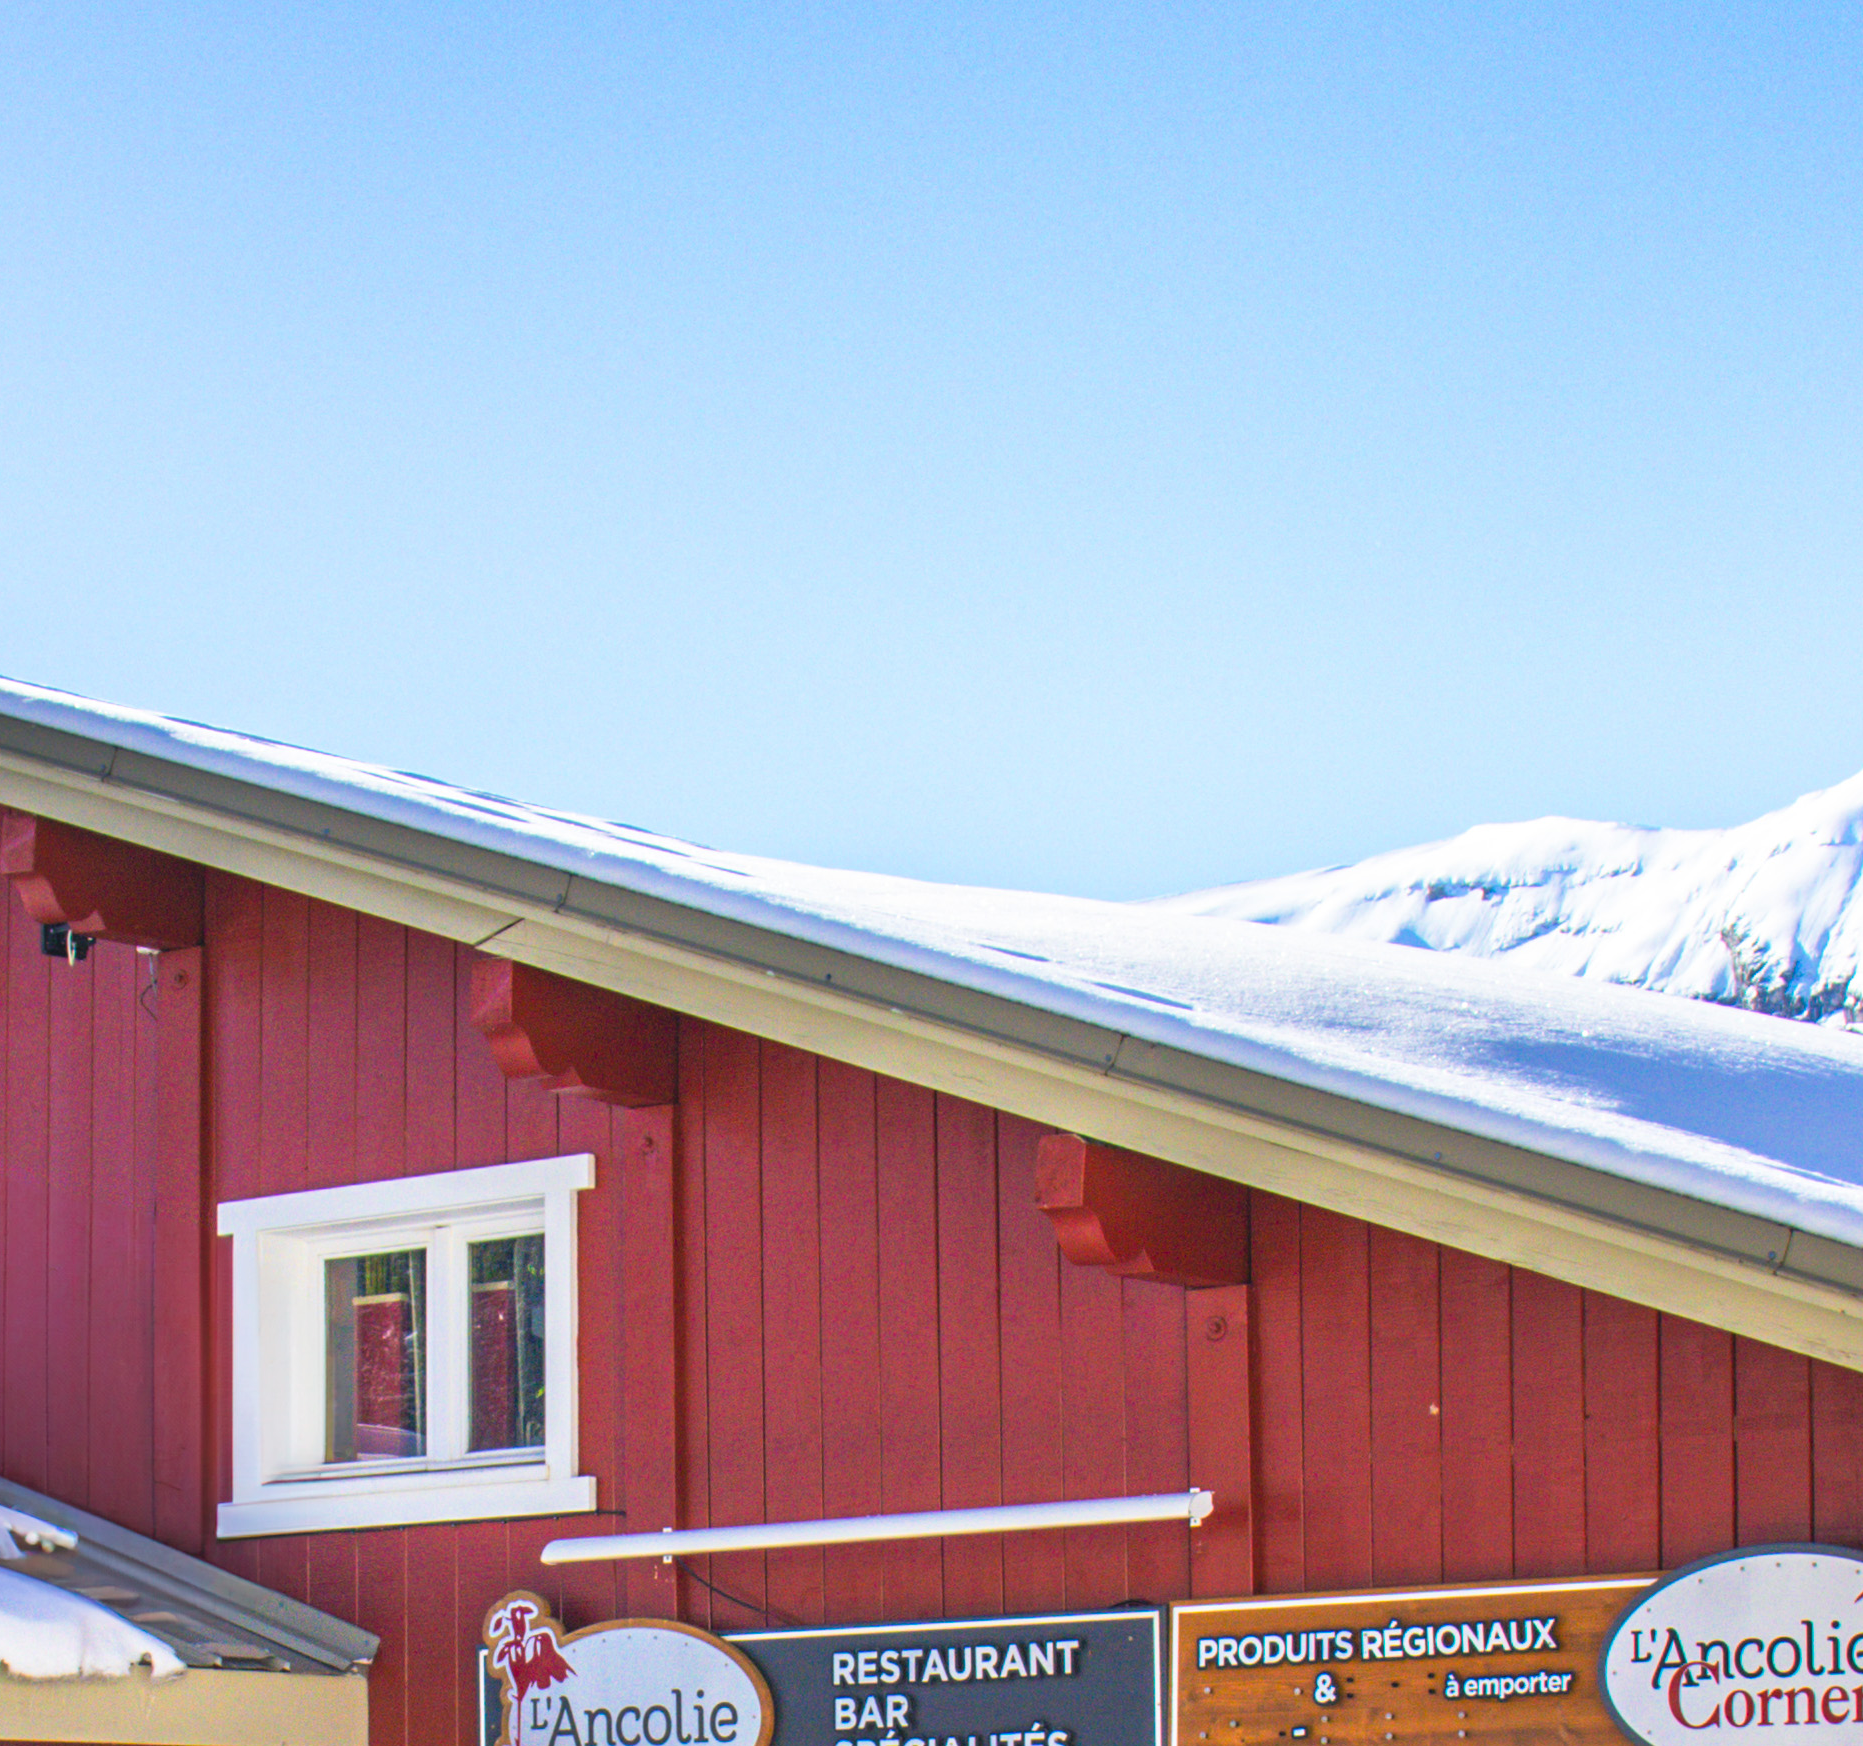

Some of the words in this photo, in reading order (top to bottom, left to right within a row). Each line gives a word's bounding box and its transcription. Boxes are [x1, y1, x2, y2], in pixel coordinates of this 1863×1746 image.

[832, 1639, 1080, 1686] RESTAURANT
[1198, 1631, 1354, 1667] PRODUITS
[1362, 1618, 1557, 1660] RÉGIONAUX
[1314, 1674, 1337, 1704] &
[1445, 1675, 1460, 1698] à
[1464, 1672, 1571, 1700] emporter
[834, 1696, 909, 1731] BAR
